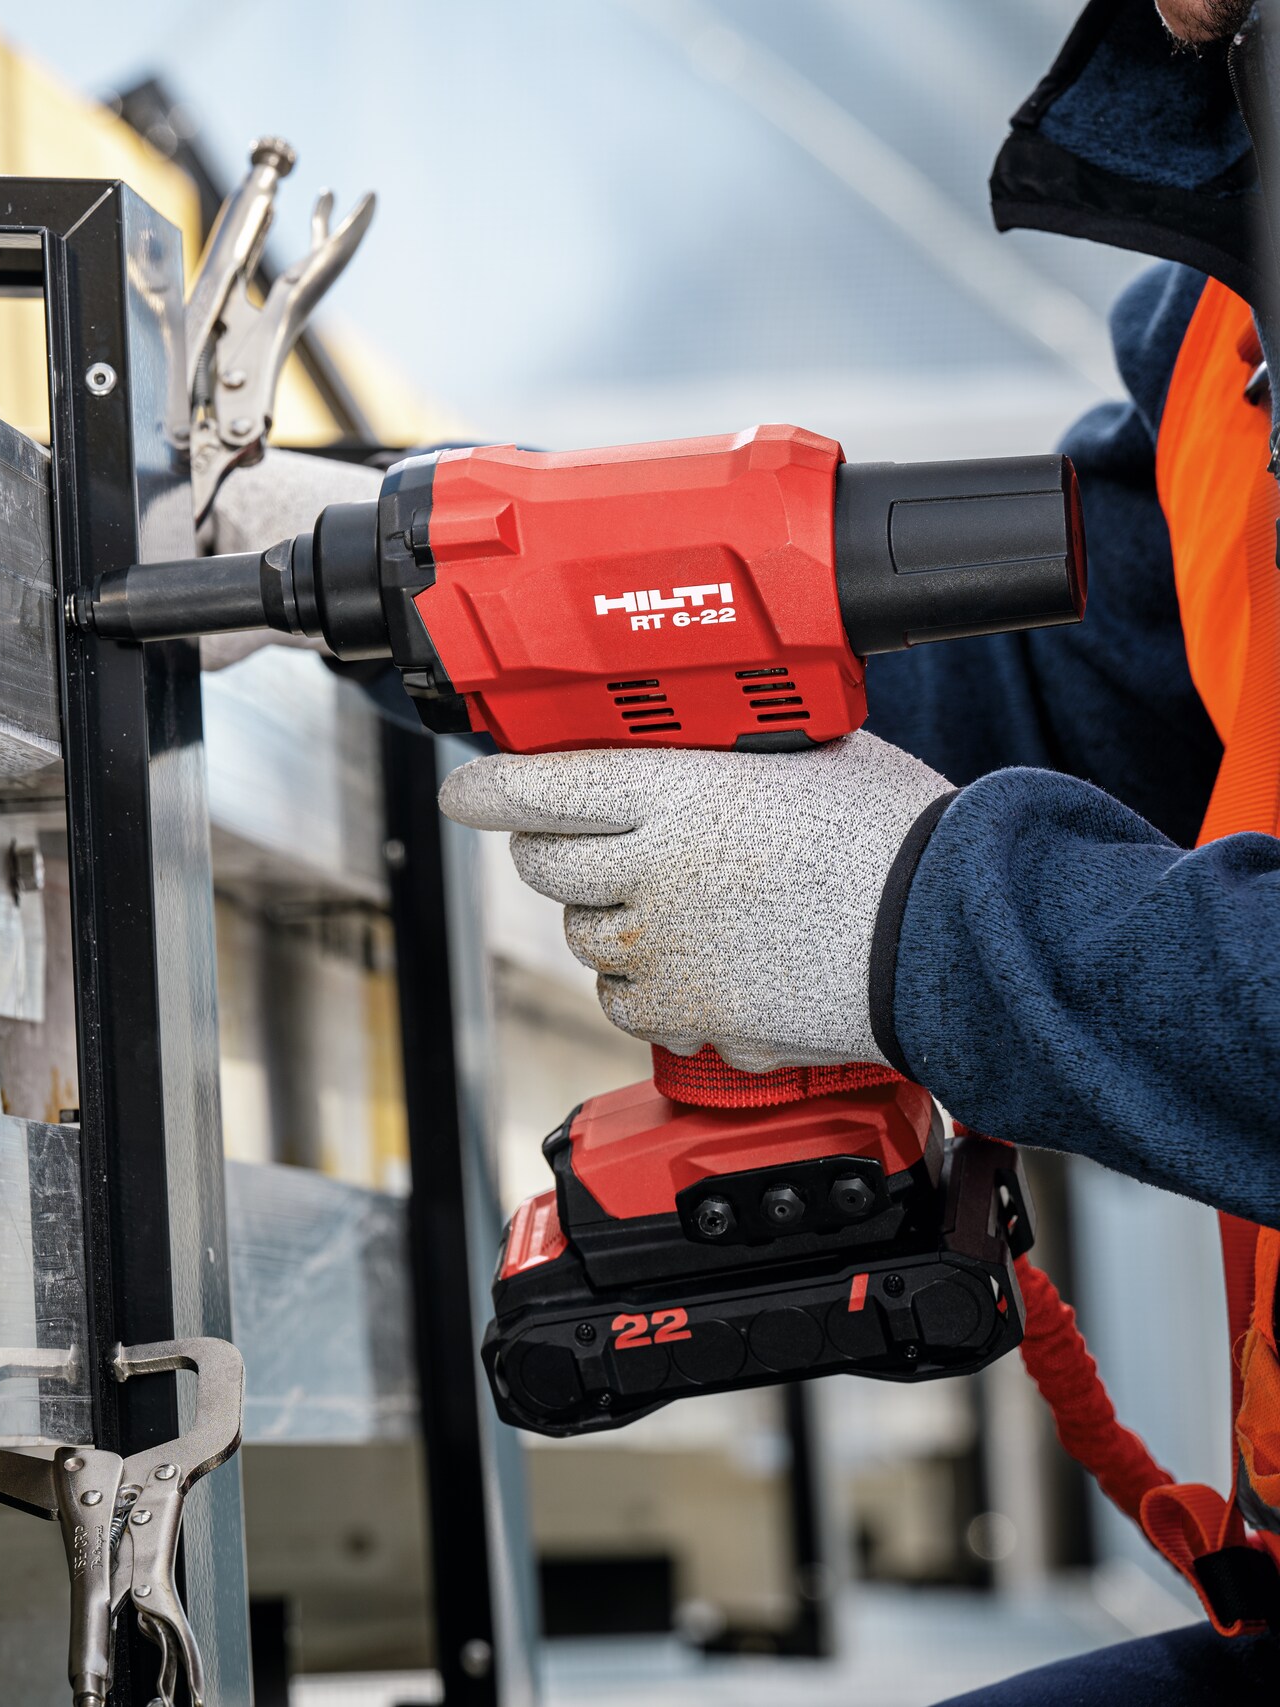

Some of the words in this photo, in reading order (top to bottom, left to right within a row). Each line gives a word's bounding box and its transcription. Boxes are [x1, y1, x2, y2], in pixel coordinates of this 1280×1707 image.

[594, 583, 734, 615] HILTI
[631, 613, 665, 631] RT
[672, 607, 736, 627] 6-22
[611, 1308, 692, 1350] 22
